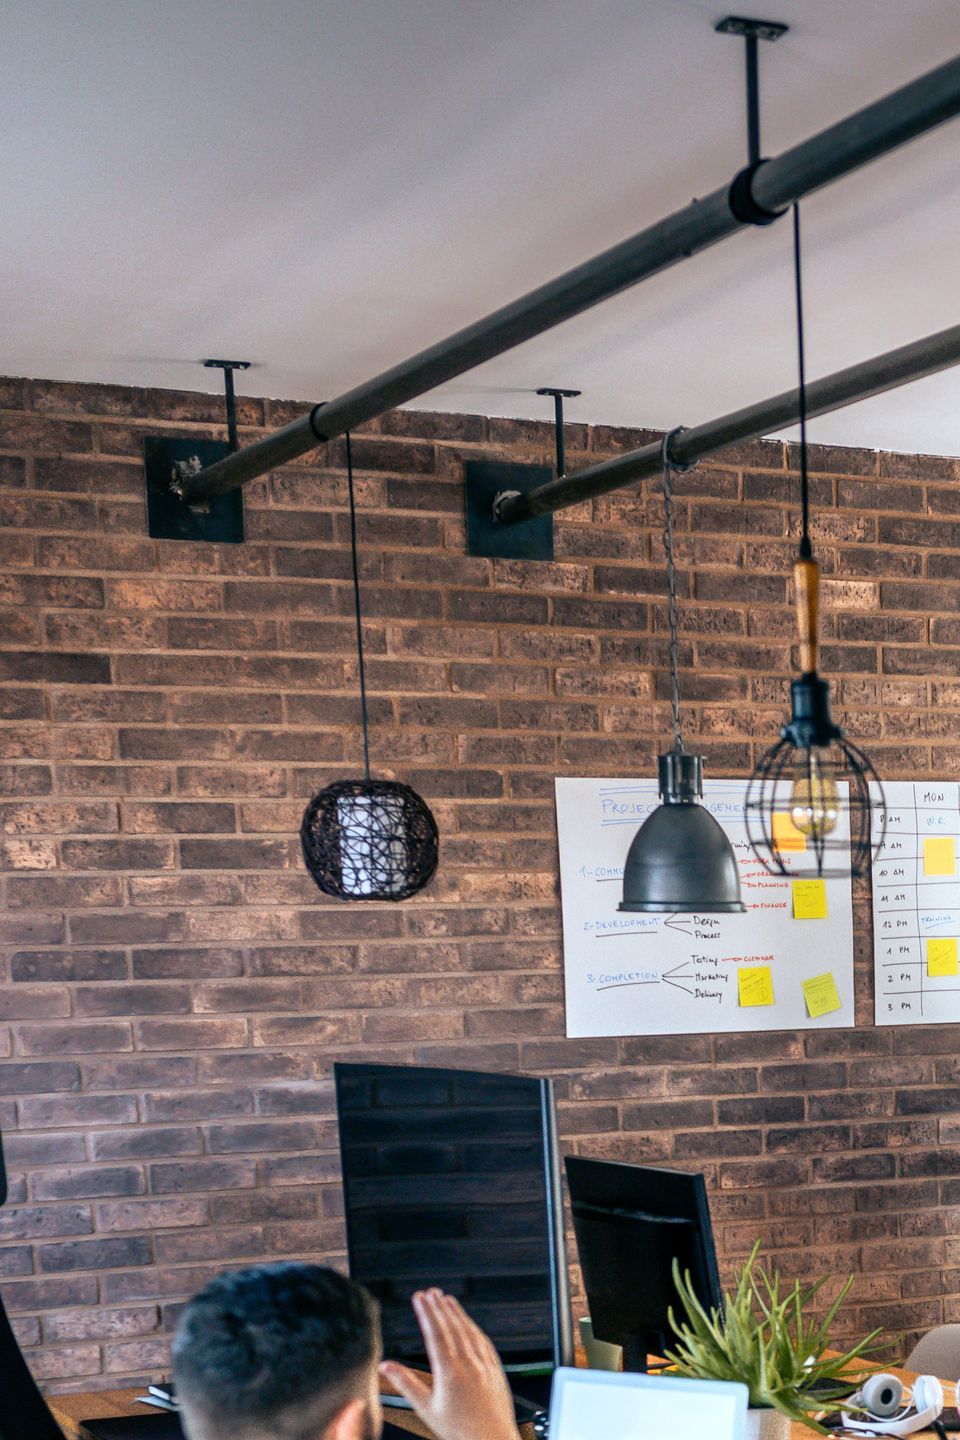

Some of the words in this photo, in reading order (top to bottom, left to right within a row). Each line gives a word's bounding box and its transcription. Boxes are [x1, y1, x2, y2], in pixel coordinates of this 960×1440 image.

[924, 792, 944, 803] MON
[880, 841, 886, 849] 9
[879, 870, 888, 878] 10
[893, 868, 905, 876] AM
[758, 881, 789, 889] PLANNING
[895, 893, 906, 901] AM
[882, 920, 892, 928] 12
[694, 930, 721, 939] Process
[691, 954, 718, 966] Testing
[695, 972, 728, 982] Marketing
[888, 975, 894, 983] 2
[900, 973, 911, 981] PM
[695, 988, 723, 1005] Delivery
[888, 1003, 893, 1011] 3
[901, 1002, 911, 1010] PM
